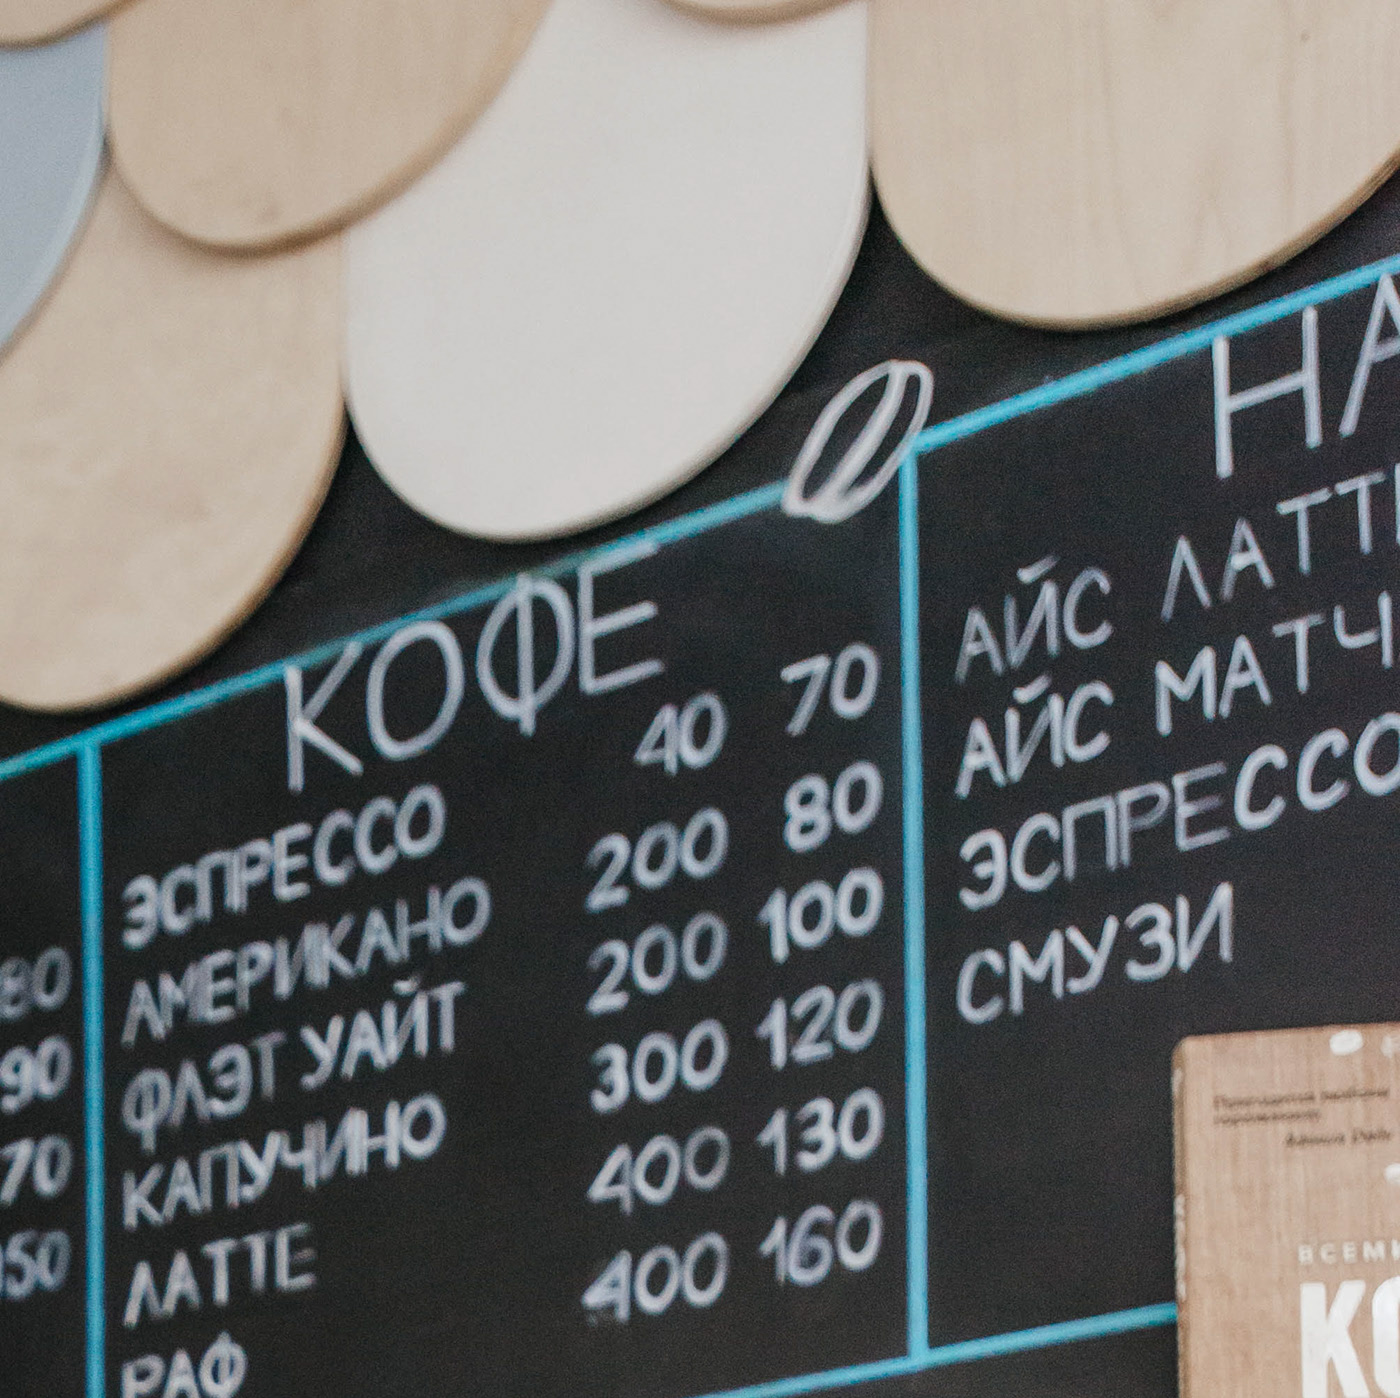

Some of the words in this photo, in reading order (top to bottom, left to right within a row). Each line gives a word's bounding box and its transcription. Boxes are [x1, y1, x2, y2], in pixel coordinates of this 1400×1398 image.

[1212, 273, 1400, 479] НА
[285, 537, 665, 791] КОФЕ
[955, 555, 1114, 685] АЙС
[1161, 462, 1400, 622] ЛАТТ
[122, 784, 446, 948] ЭСПРЕССО
[635, 691, 728, 775] 40
[782, 643, 879, 736] 70
[955, 673, 1114, 799] АЙС
[1155, 590, 1393, 737] МАТЧ
[122, 877, 491, 1048] АМЕРИКАНО
[586, 808, 729, 911] 200
[783, 761, 884, 852] 80
[956, 711, 1400, 912] ЭСПРЕССО
[122, 1029, 286, 1153] ФЛЭТ
[300, 975, 467, 1086] УАЙТ
[586, 913, 729, 1014] 200
[759, 867, 884, 963] 100
[955, 881, 1235, 1025] СМУЗИ
[0, 1135, 72, 1206] 70
[122, 1092, 447, 1231] КАПУЧИНО
[590, 1018, 729, 1113] 300
[755, 979, 884, 1070] 120
[122, 1222, 317, 1328] ЛАТТЕ
[587, 1126, 731, 1215] 400
[755, 1088, 885, 1174] 130
[581, 1231, 729, 1325] 400
[759, 1200, 883, 1287] 160
